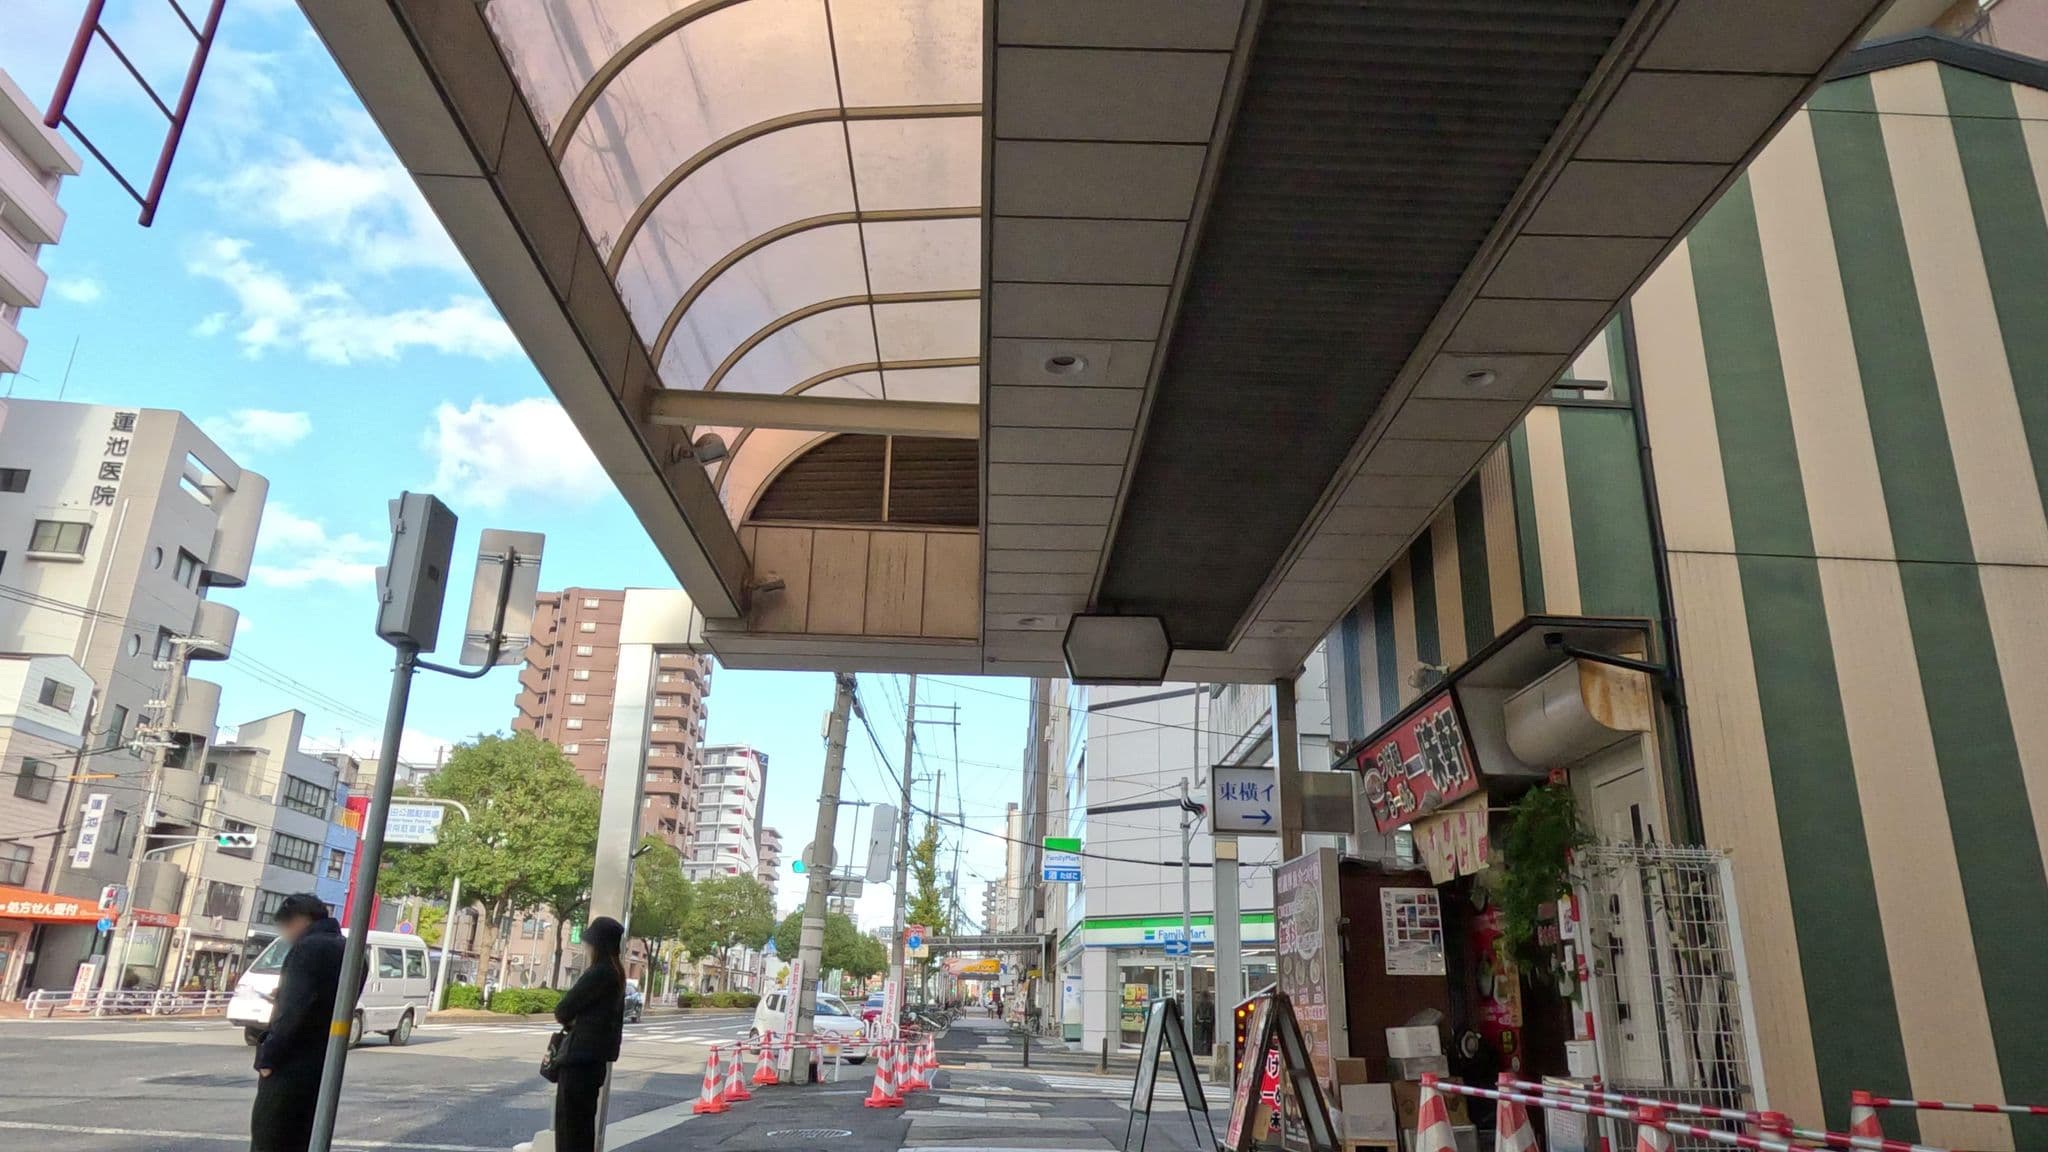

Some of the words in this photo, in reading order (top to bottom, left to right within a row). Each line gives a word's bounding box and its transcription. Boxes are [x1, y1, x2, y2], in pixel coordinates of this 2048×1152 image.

[89, 411, 138, 507] 蓮池医院
[1219, 781, 1275, 802] 東横イ
